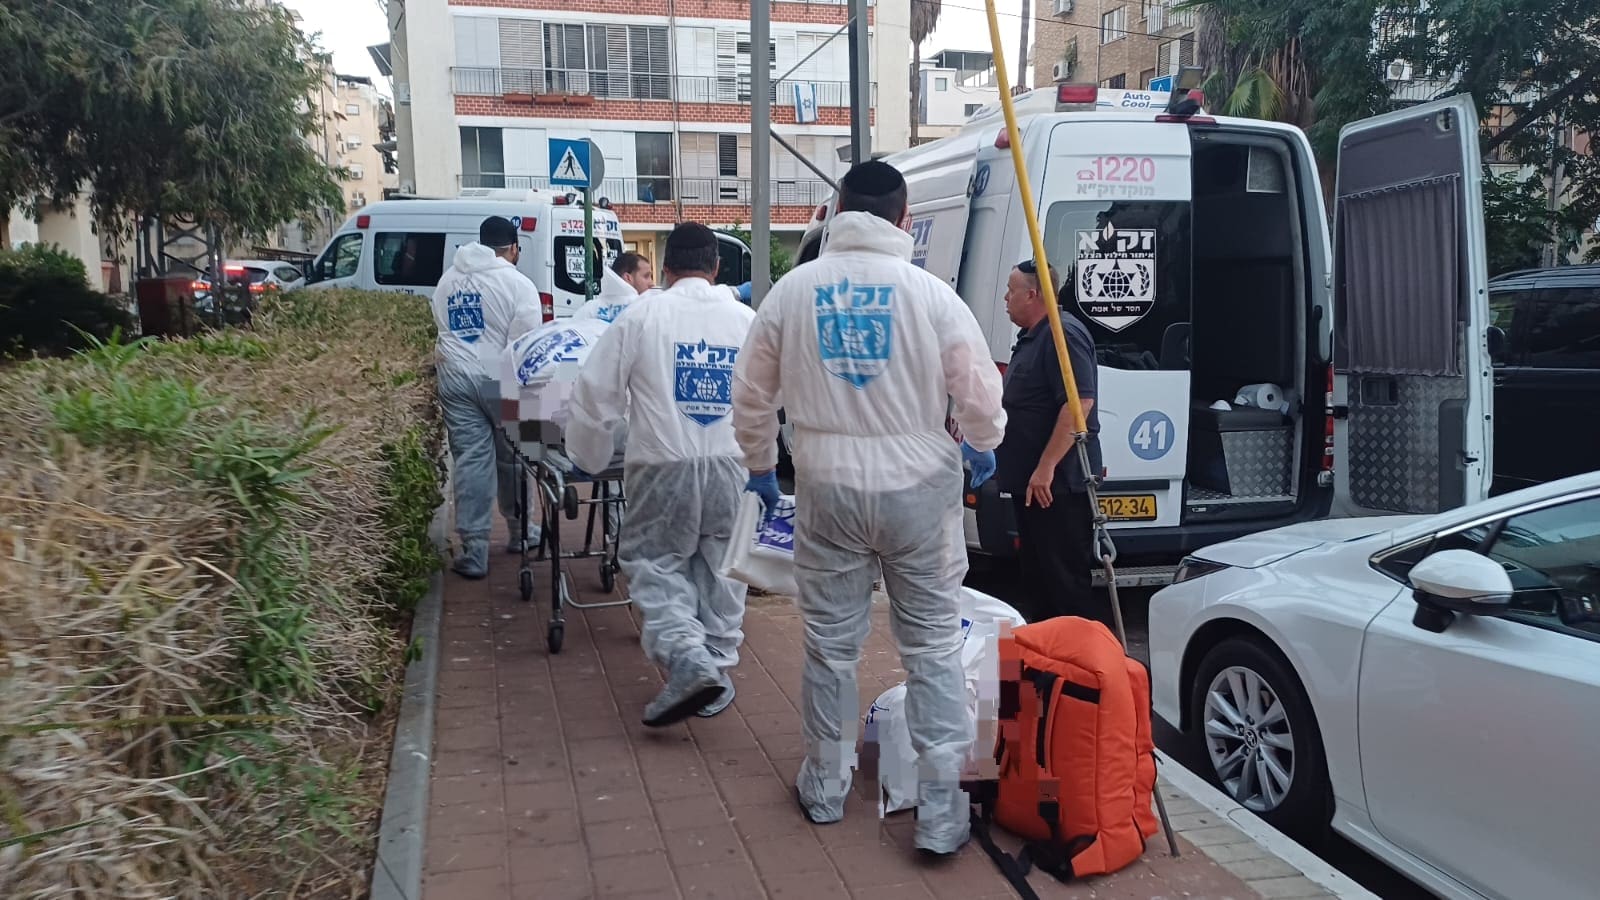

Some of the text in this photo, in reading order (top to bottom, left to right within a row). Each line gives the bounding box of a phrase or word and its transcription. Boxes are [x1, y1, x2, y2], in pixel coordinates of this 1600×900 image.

[1123, 92, 1151, 100] Auto
[1121, 100, 1151, 108] Cool
[1092, 156, 1155, 182] 1220
[1118, 185, 1155, 198] מוקד
[1078, 251, 1102, 259] הצלה
[1104, 251, 1128, 259] חילוץ
[1111, 303, 1122, 312] של
[1133, 420, 1167, 450] 41
